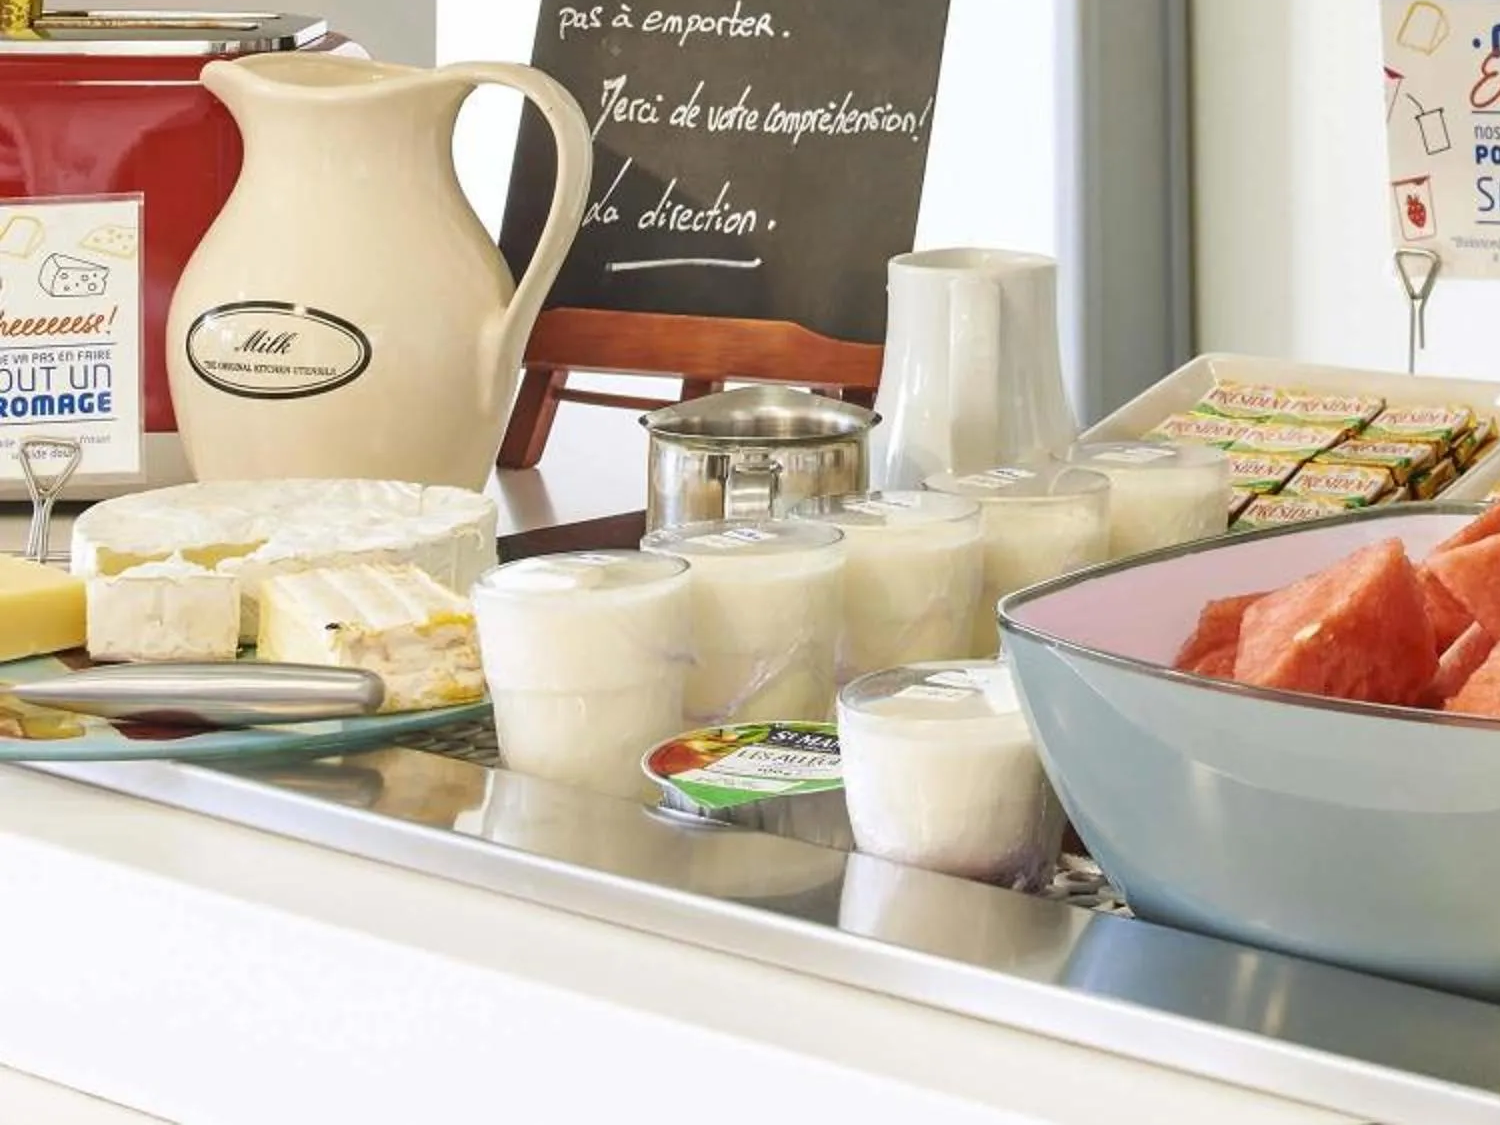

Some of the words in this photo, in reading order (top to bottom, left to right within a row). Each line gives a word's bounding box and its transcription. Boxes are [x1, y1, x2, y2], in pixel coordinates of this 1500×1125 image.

[559, 7, 603, 40] pas
[611, 3, 634, 28] à
[669, 80, 705, 128] de
[707, 85, 759, 133] votre
[1474, 126, 1500, 141] NOS
[31, 352, 55, 363] PAS
[77, 349, 112, 361] FAIRE
[234, 330, 299, 355] Milk
[0, 366, 57, 393] OUT
[69, 363, 111, 390] UN
[0, 391, 112, 418] ROMAGE
